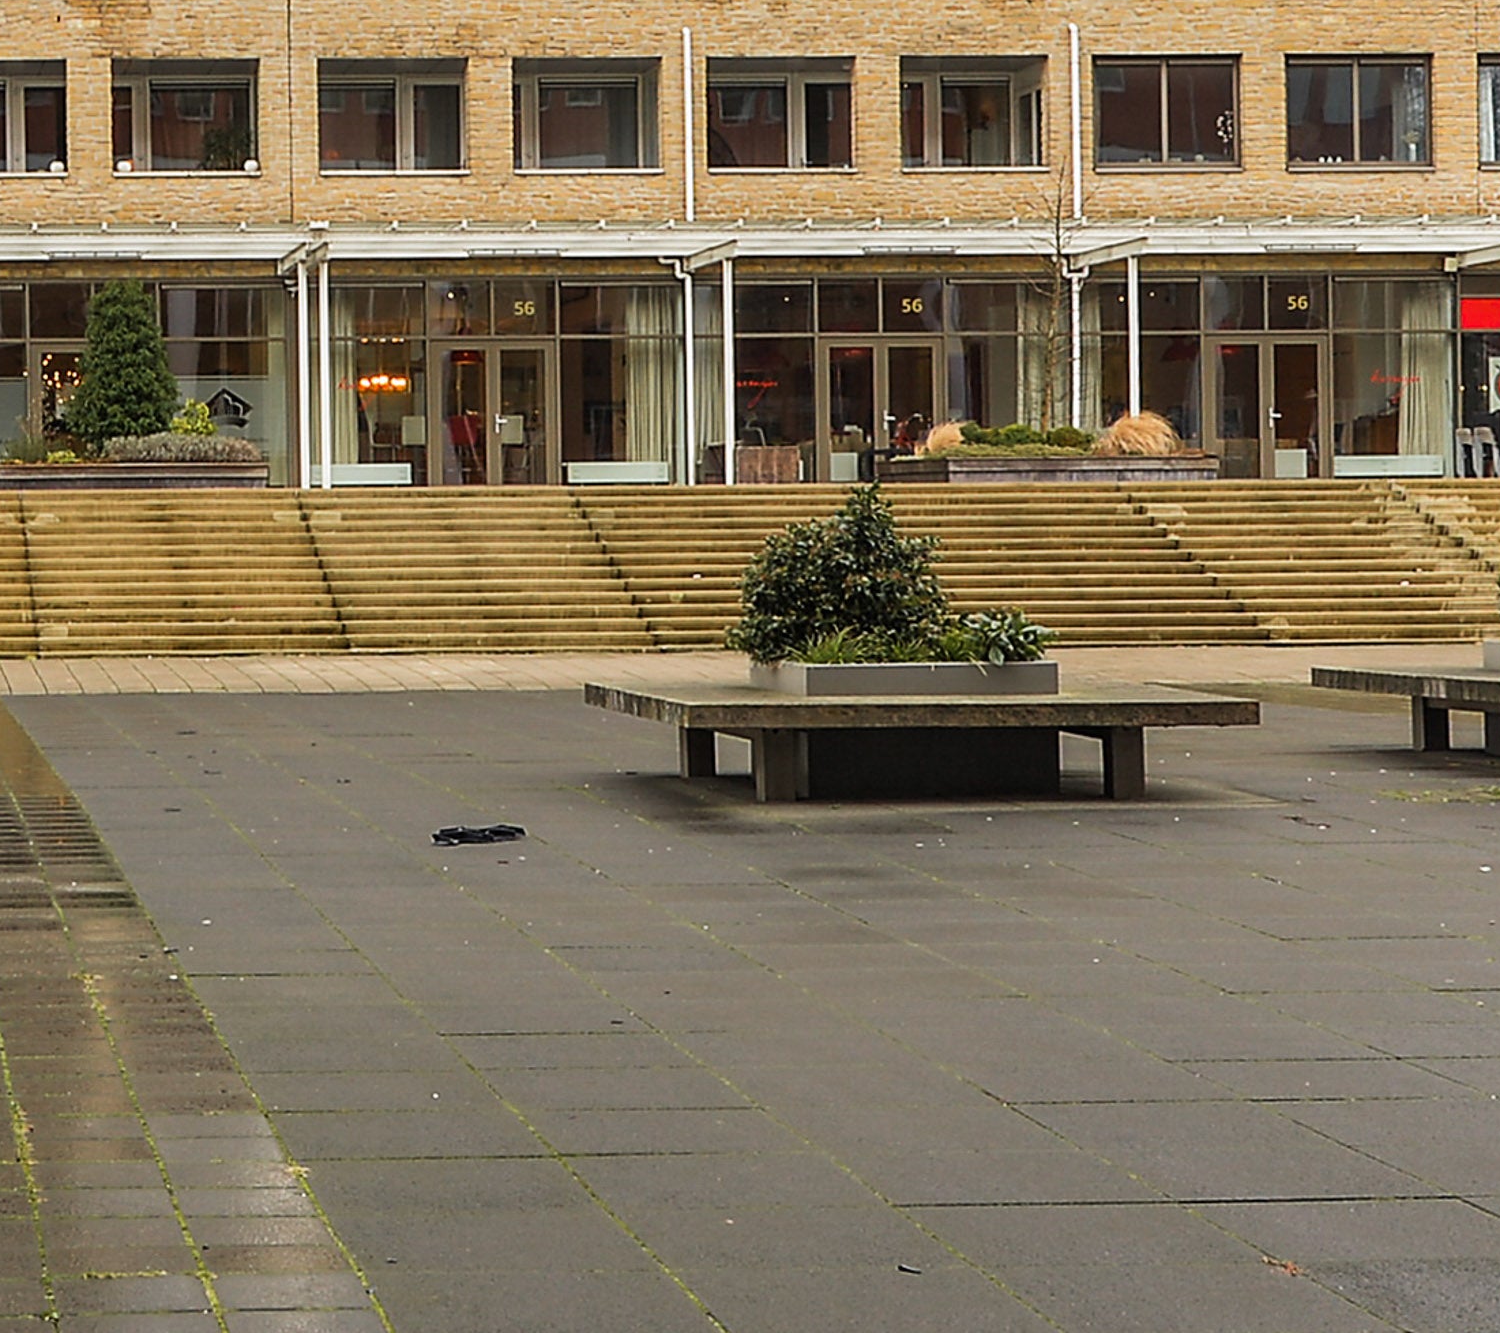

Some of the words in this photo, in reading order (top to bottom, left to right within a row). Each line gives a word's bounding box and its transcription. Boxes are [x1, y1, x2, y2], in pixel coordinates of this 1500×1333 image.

[513, 301, 536, 316] 56
[901, 298, 924, 313] 56
[1287, 295, 1309, 311] 56
